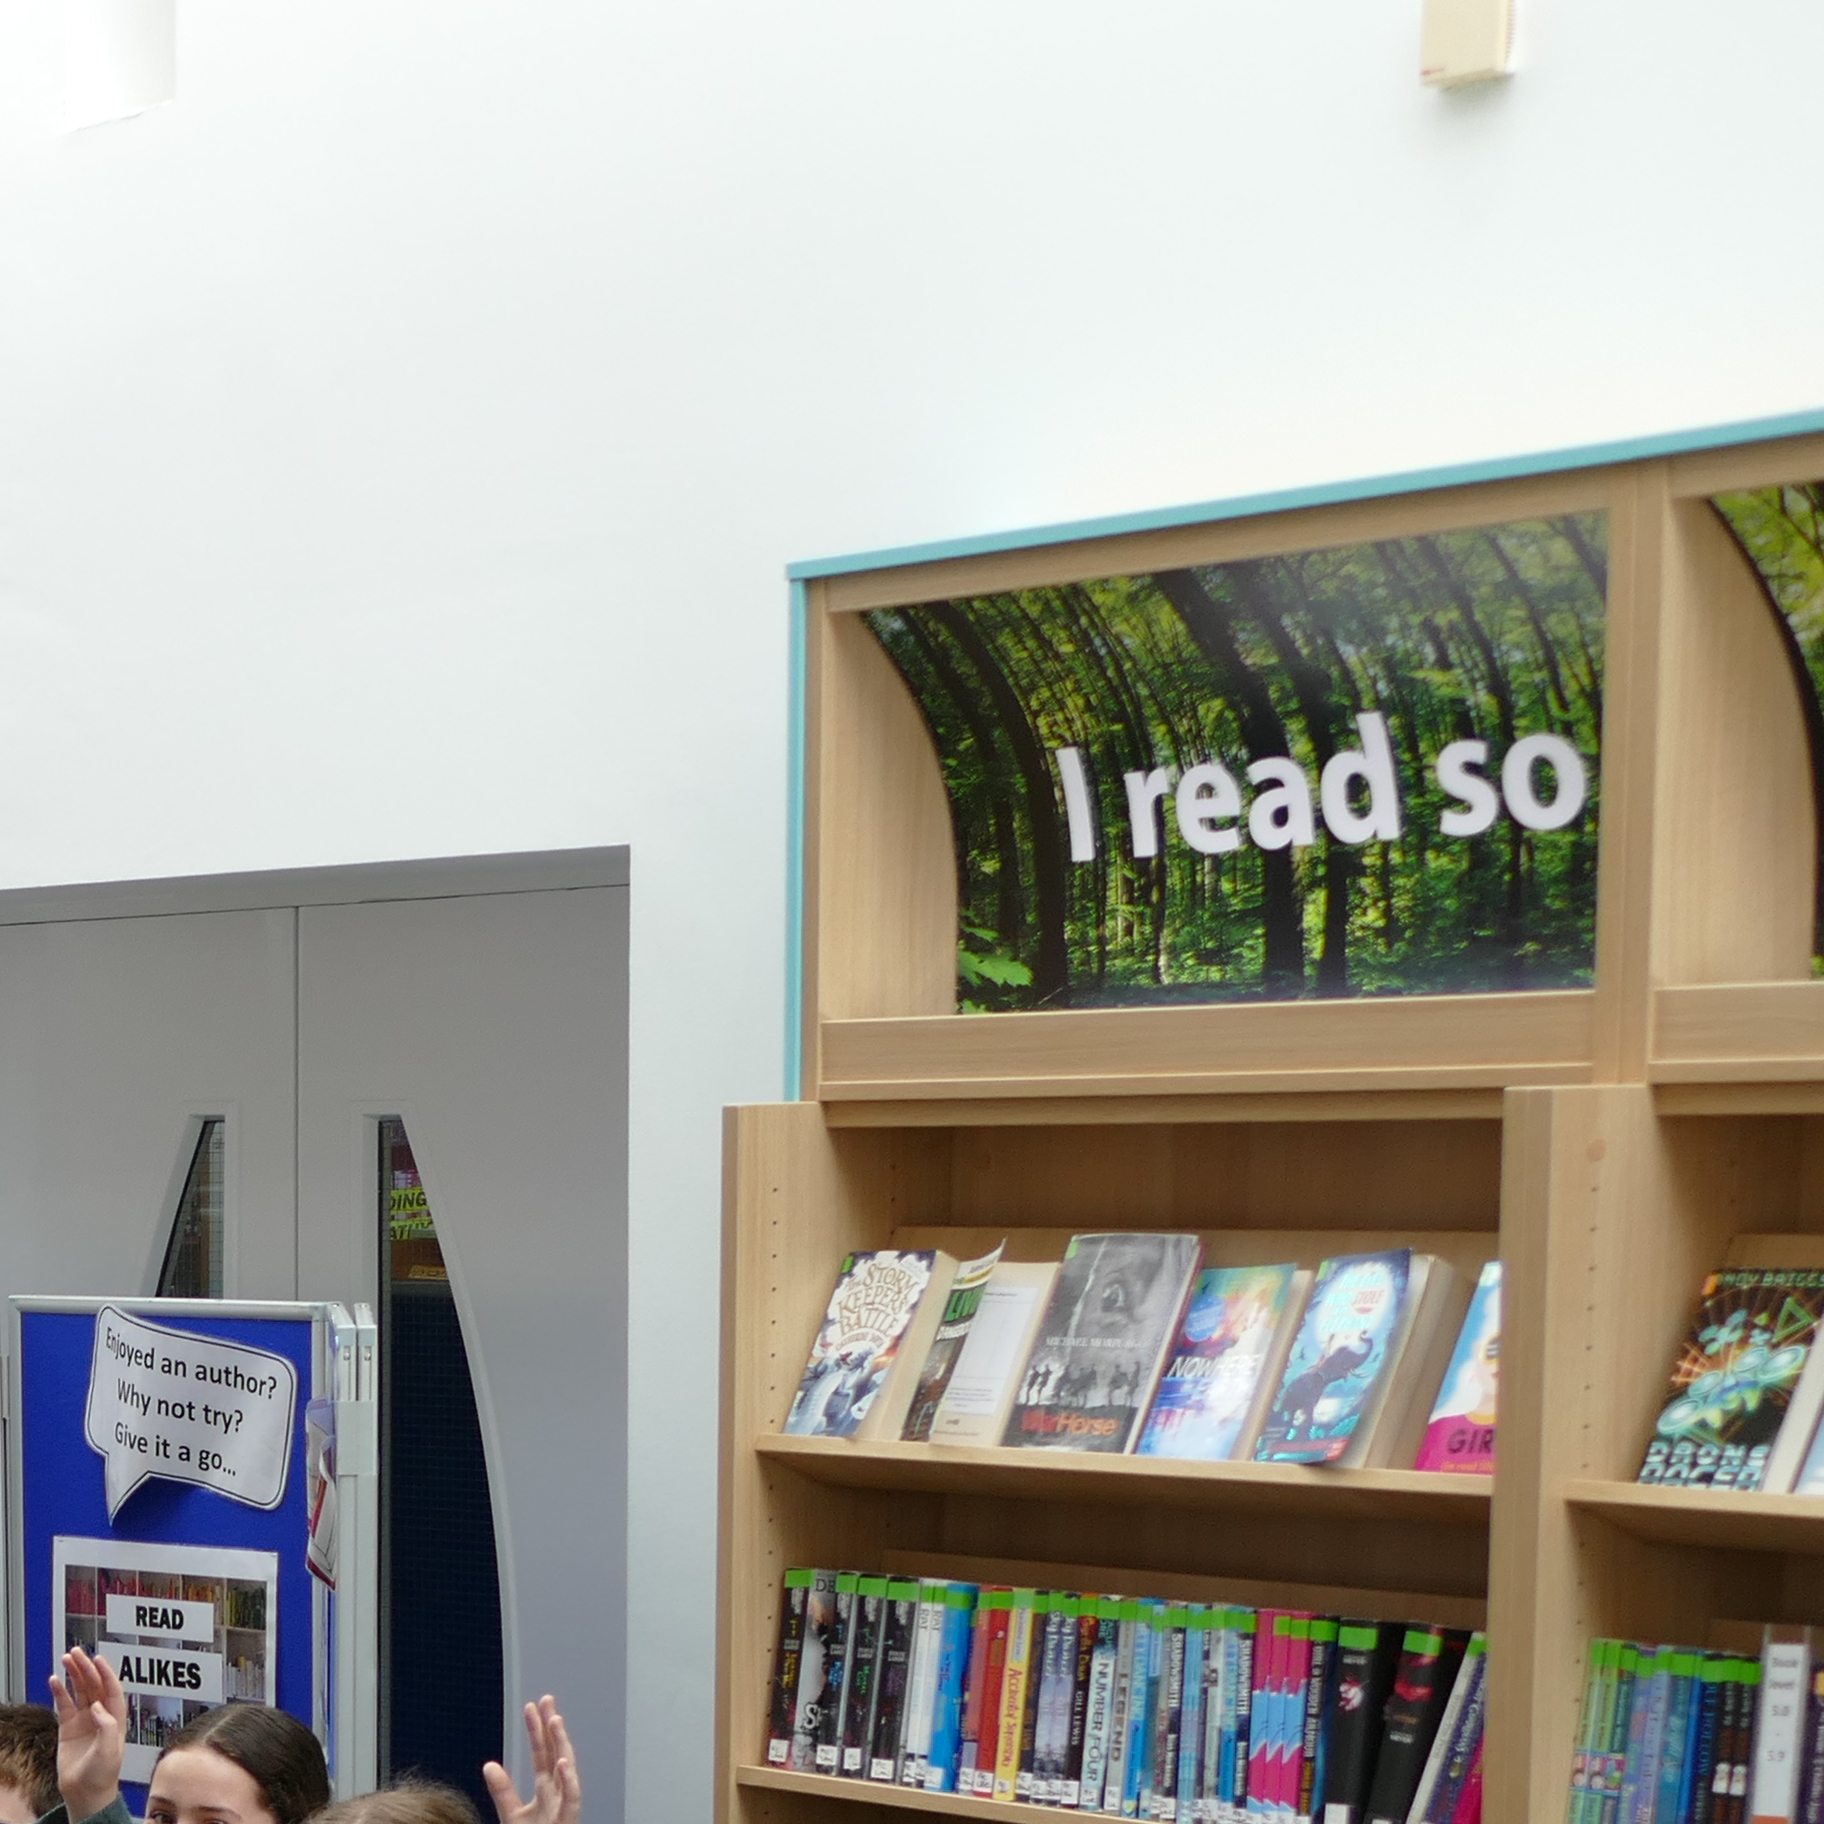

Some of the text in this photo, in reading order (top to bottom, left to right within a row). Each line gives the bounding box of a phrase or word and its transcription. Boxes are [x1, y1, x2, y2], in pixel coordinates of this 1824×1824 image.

[1054, 710, 1590, 863] I read so
[863, 1264, 918, 1295] STORM
[840, 1306, 898, 1334] BATTLE
[1045, 1337, 1149, 1349] MICHAEL MORPURGO
[106, 1327, 277, 1400] Enjoyed an author?
[1167, 1354, 1260, 1379] NOWHERE
[118, 1378, 243, 1435] Why not try?
[1056, 1412, 1119, 1436] Horse
[115, 1422, 236, 1476] Give it a go...
[1646, 1441, 1770, 1466] DRONE
[136, 1605, 184, 1630] READ
[918, 1608, 930, 1631] RAT
[931, 1609, 942, 1634] RAT
[119, 1655, 202, 1690] ALIKES
[1167, 1633, 1183, 1708] SHADOWSMITH
[1236, 1639, 1252, 1716] SHADOWSMITH
[1086, 1661, 1111, 1782] NUMBER FOUR
[1110, 1672, 1129, 1762] LEGEND
